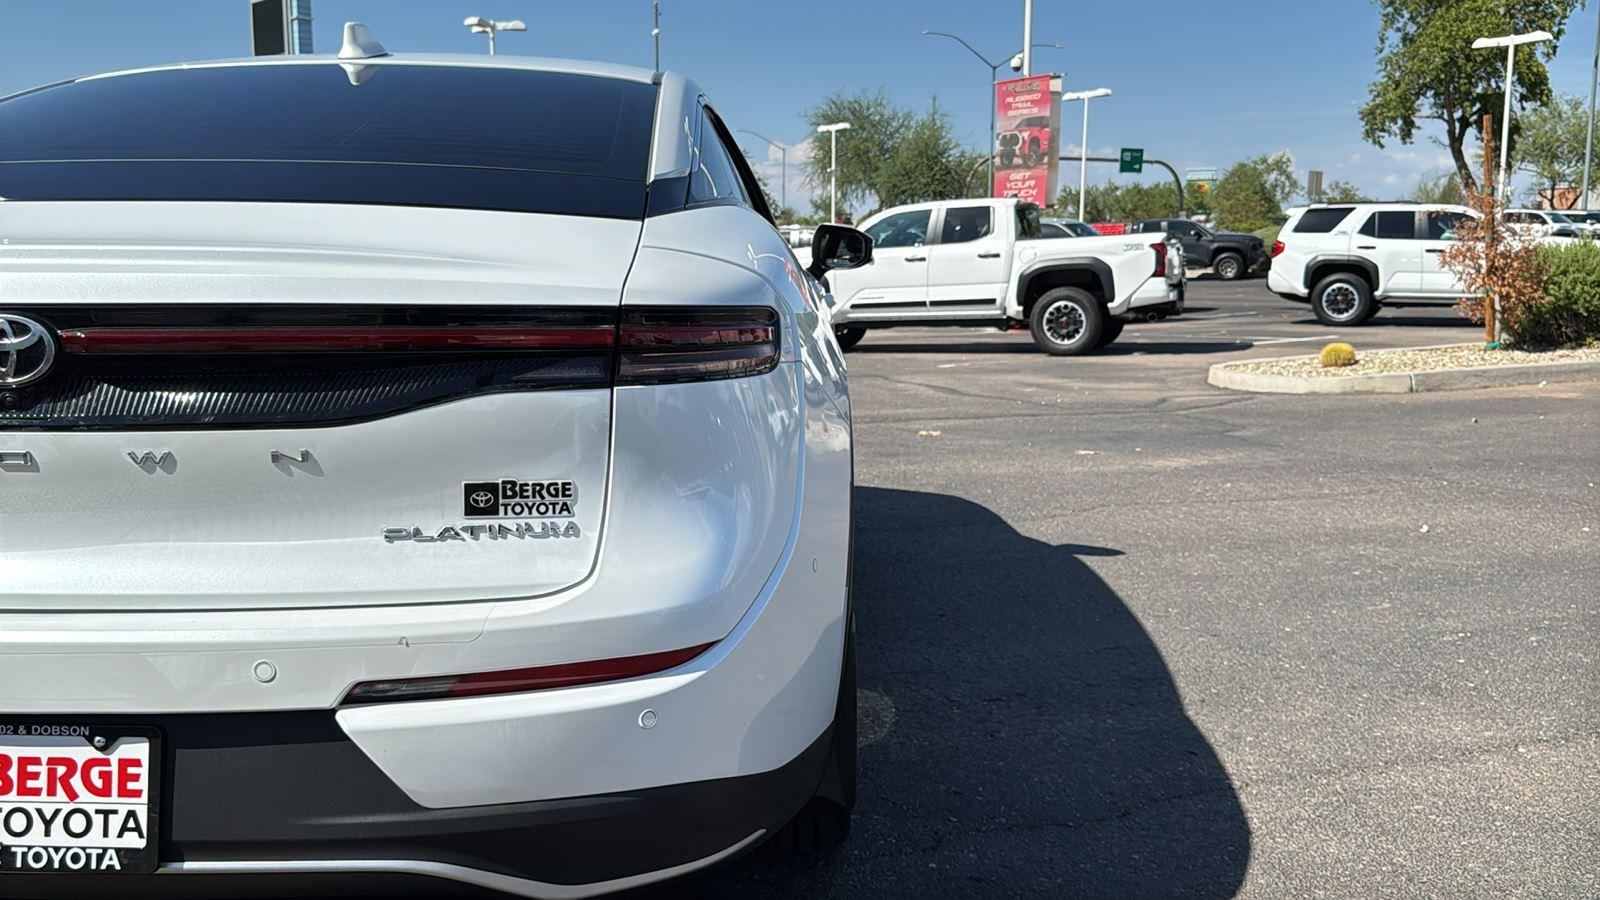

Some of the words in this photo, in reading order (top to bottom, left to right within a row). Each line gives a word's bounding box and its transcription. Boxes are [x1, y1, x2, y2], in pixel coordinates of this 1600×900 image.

[1006, 180, 1036, 189] YOUR
[1009, 172, 1031, 181] GET
[501, 480, 572, 501] BERGE
[501, 502, 571, 516] TOYOTA
[383, 521, 579, 542] PLATINUM
[18, 725, 27, 735] &
[31, 726, 90, 736] DOBSON
[0, 806, 145, 839] OYOTA
[11, 847, 121, 870] TOYOTA
